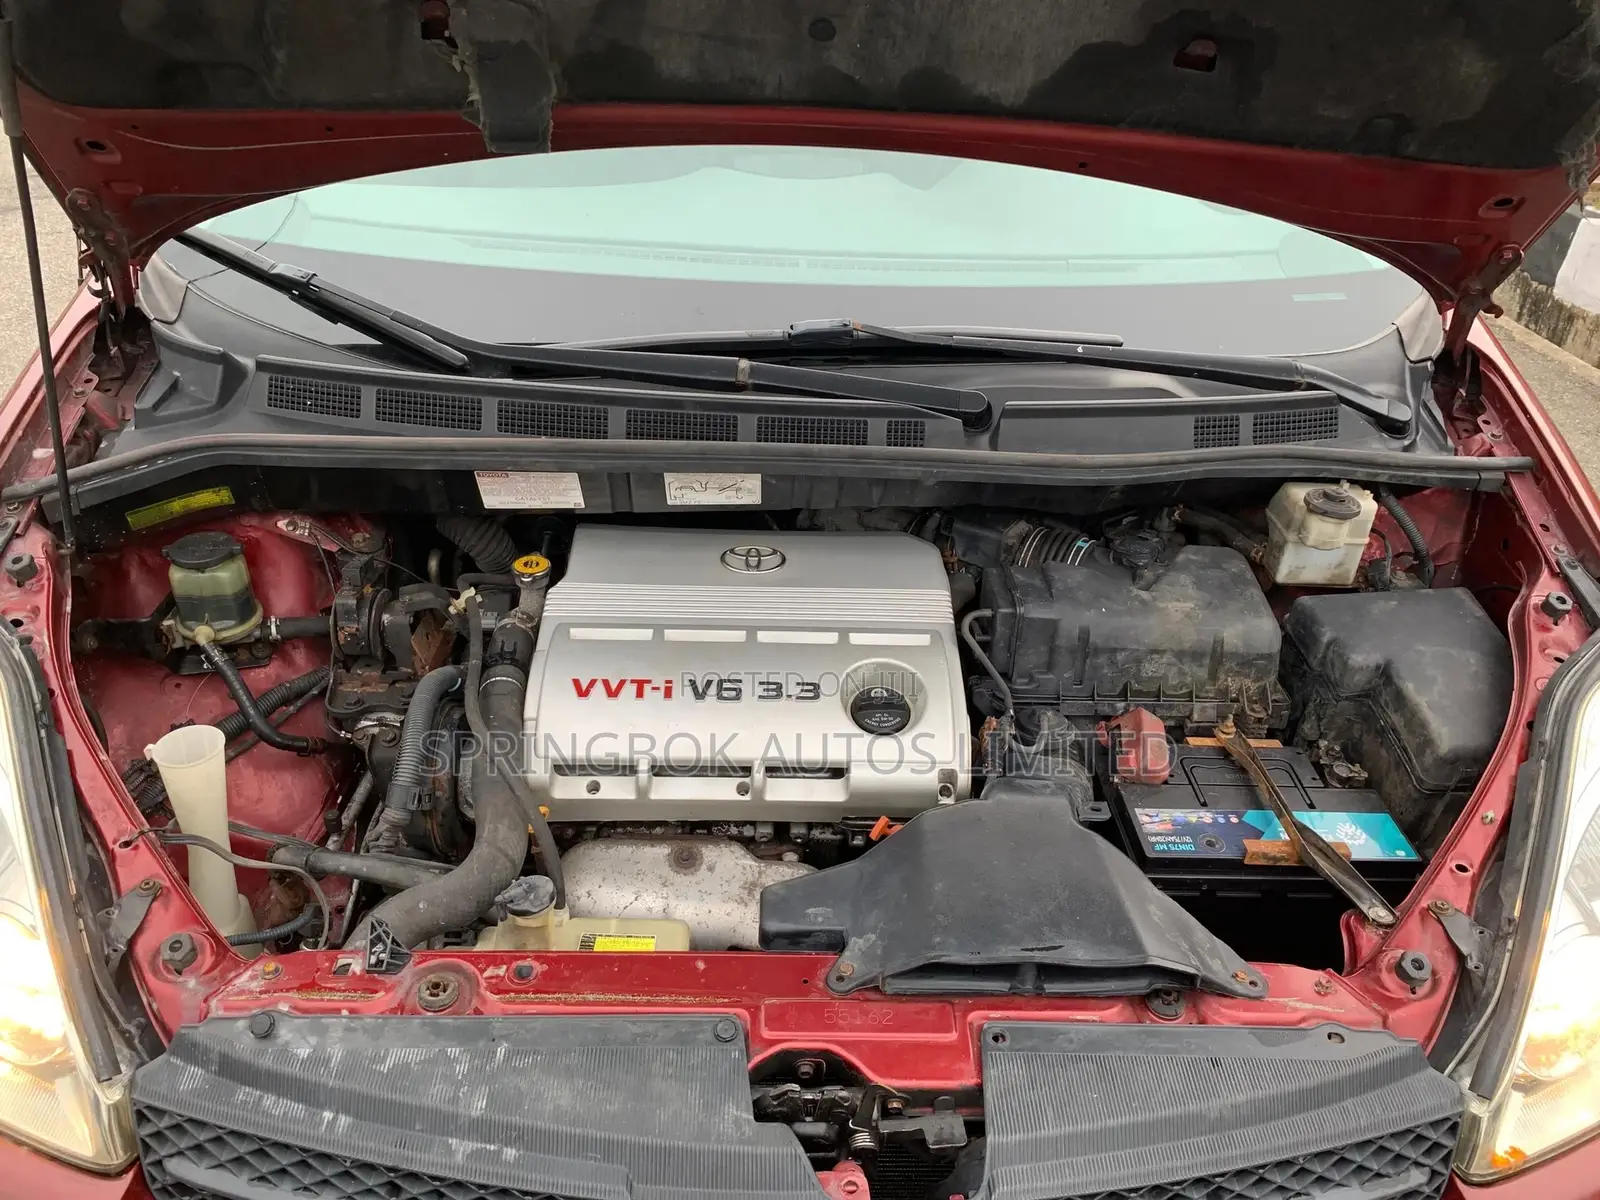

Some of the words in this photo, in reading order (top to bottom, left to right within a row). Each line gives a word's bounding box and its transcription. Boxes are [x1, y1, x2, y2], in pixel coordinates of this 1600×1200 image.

[571, 677, 674, 700] VVT-i
[687, 678, 743, 703] V6
[757, 680, 822, 703] 3.3
[1153, 843, 1168, 851] MF
[1168, 843, 1196, 851] DIN75
[823, 1008, 894, 1025] 55162
